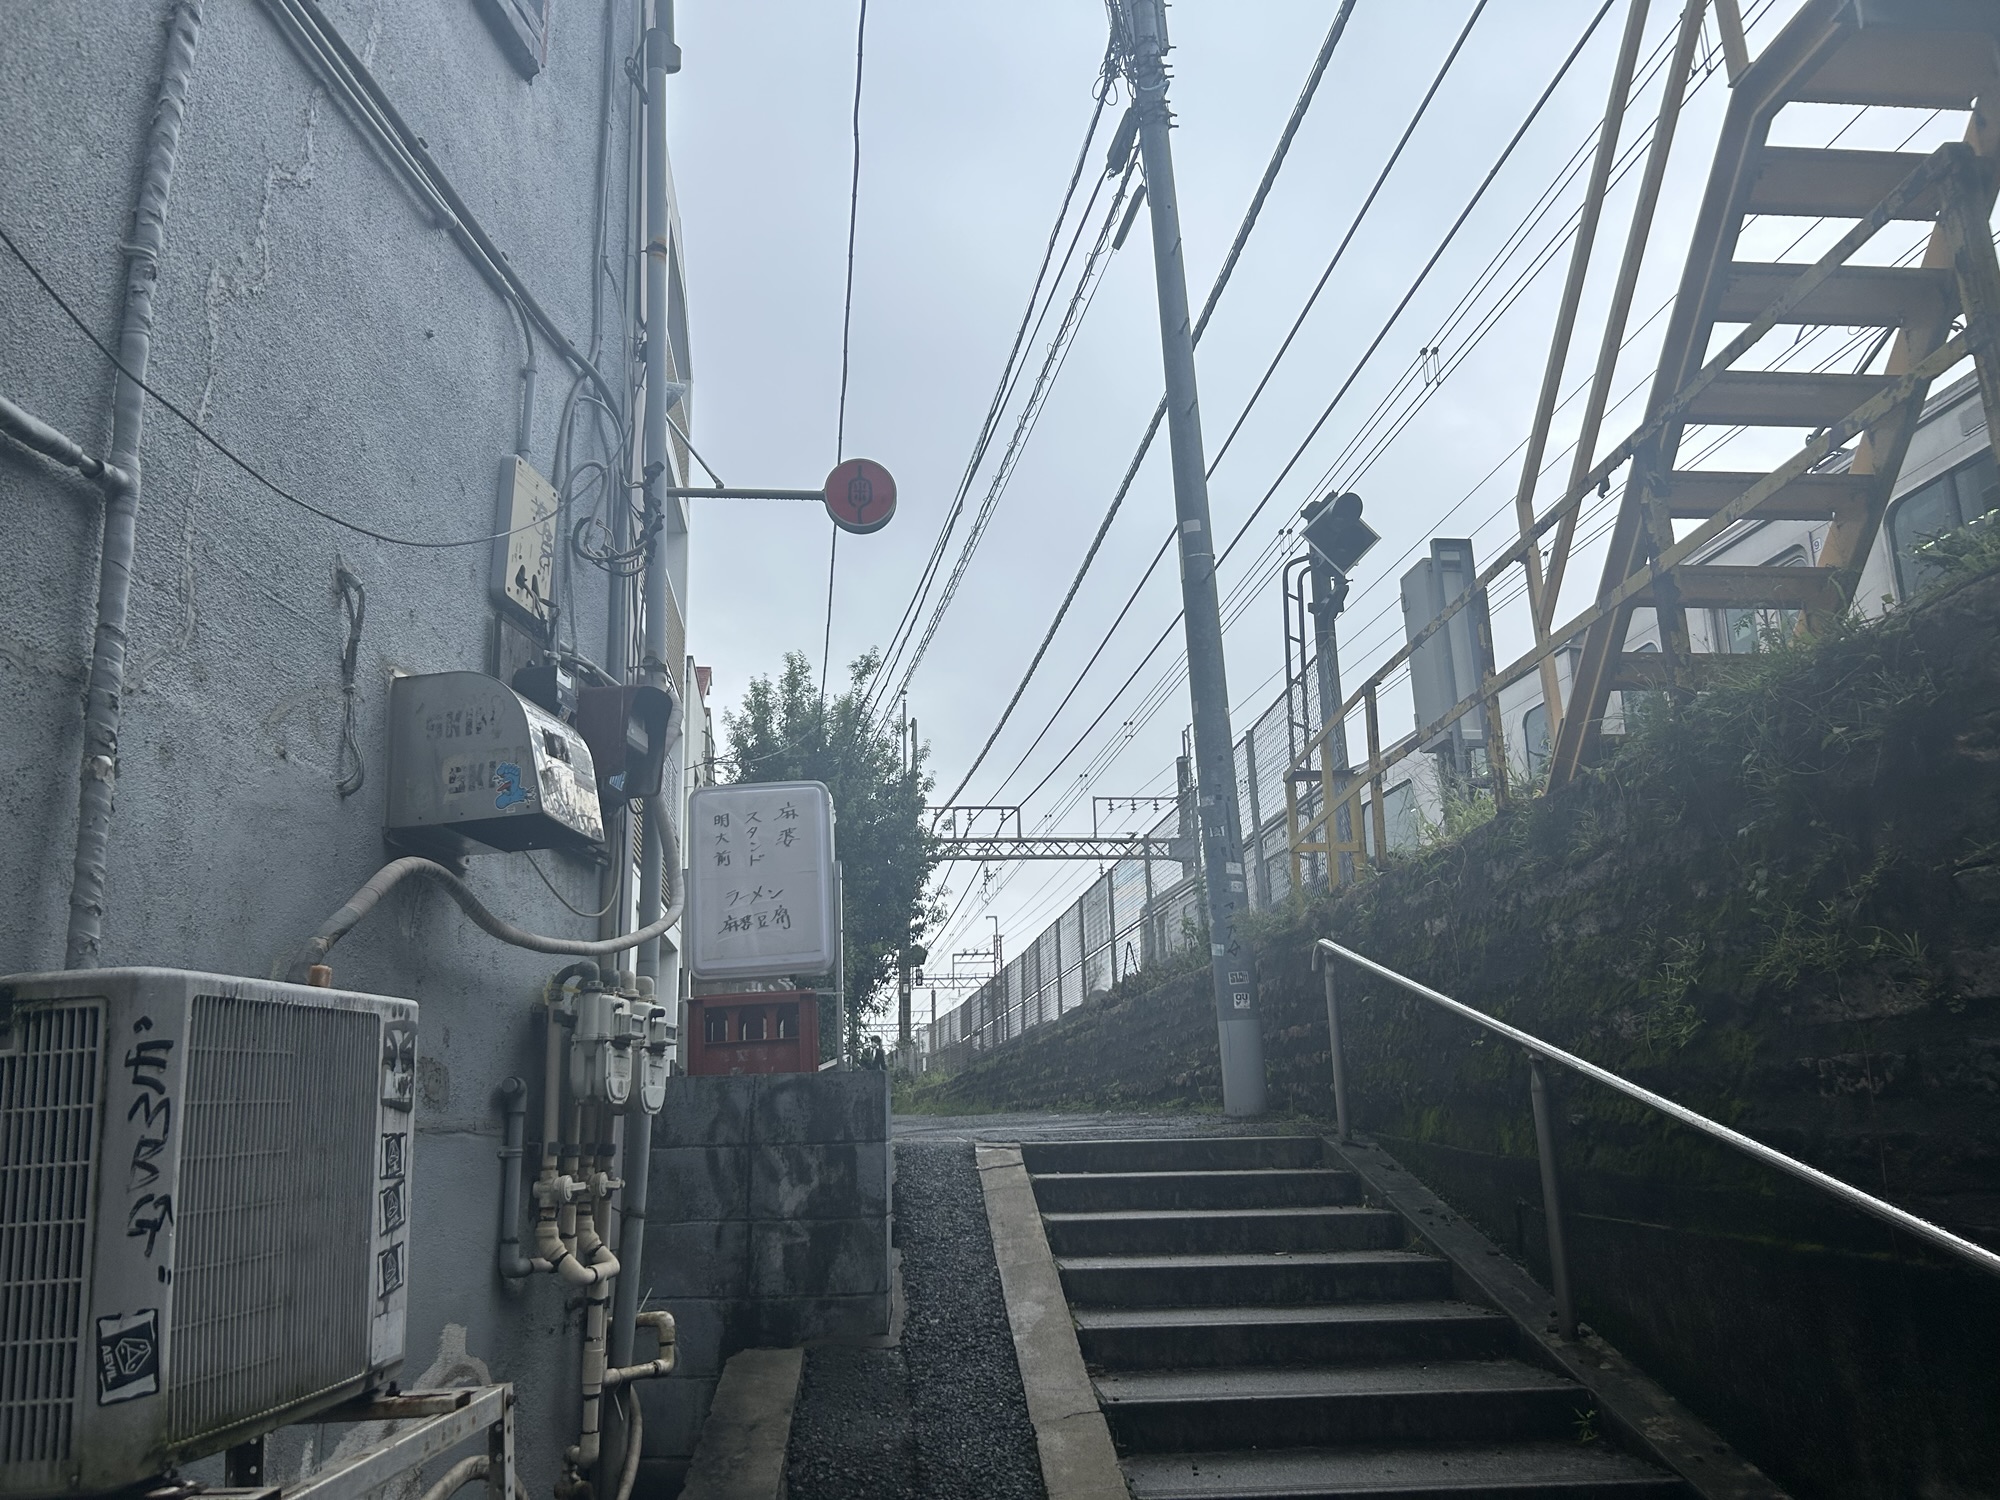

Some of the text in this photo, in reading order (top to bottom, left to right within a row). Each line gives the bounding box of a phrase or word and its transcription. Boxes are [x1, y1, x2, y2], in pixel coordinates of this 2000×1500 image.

[713, 813, 731, 867] 明大前
[746, 811, 765, 866] スタンド
[774, 802, 800, 847] 麻婆
[726, 885, 784, 906] ラーメン
[101, 1345, 117, 1384] AEVIL
